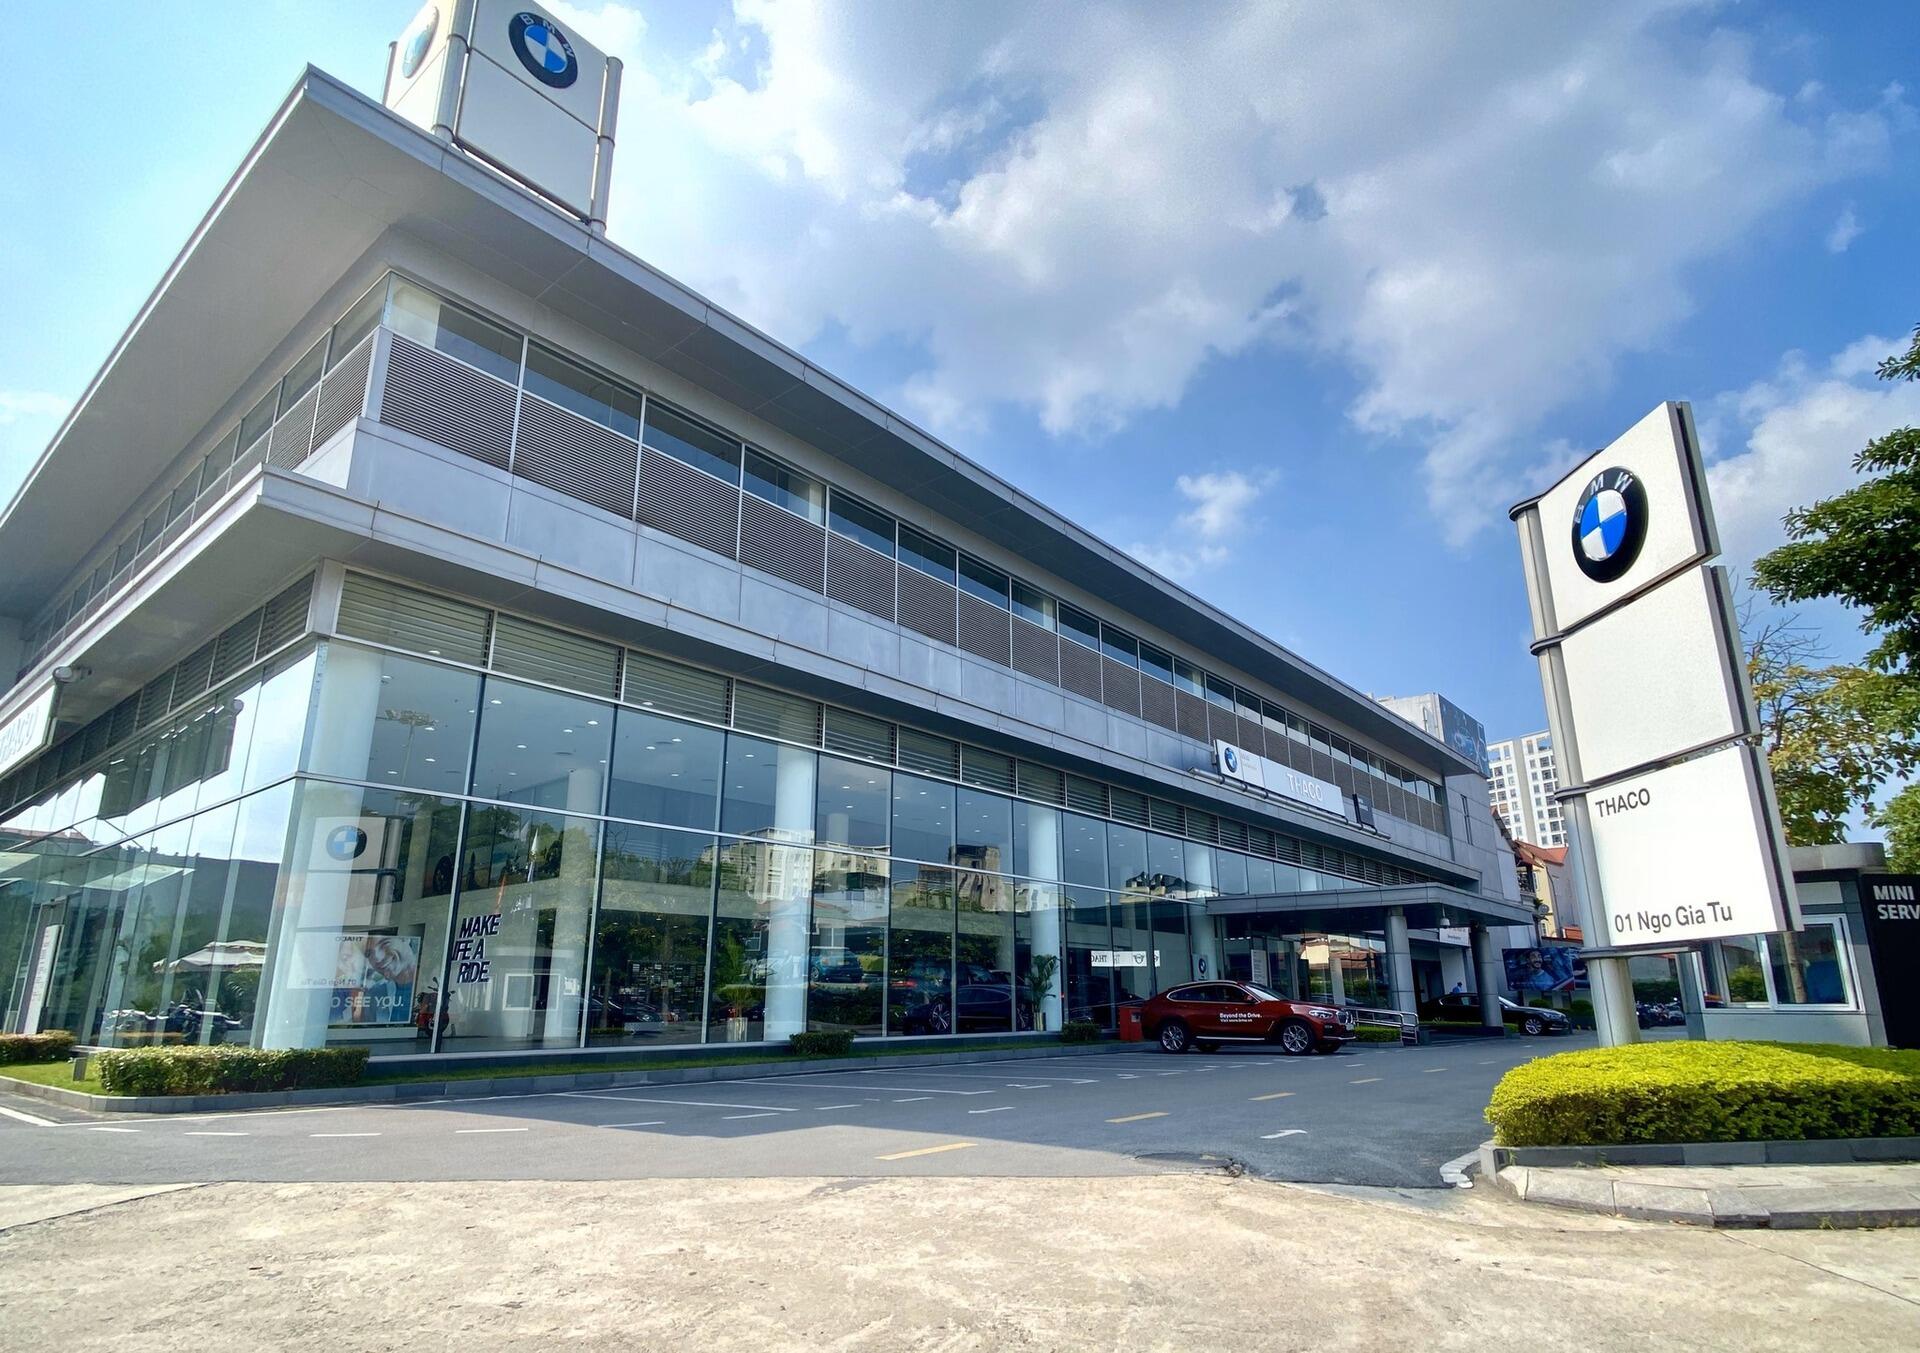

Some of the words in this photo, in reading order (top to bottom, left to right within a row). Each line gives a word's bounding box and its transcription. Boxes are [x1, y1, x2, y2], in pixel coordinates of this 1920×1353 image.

[1286, 771, 1323, 802] THACO
[1595, 788, 1650, 818] THACO
[1872, 885, 1915, 901] MINI
[1614, 912, 1634, 933] 01
[1637, 909, 1672, 934] Ngo
[1675, 905, 1706, 926] Gia
[1707, 900, 1734, 923] Tu
[1877, 904, 1920, 920] SERV
[459, 914, 502, 938] MAKE
[473, 938, 485, 960] A
[457, 961, 490, 984] RIDE
[344, 996, 371, 1008] SEE
[375, 996, 404, 1007] YOU.
